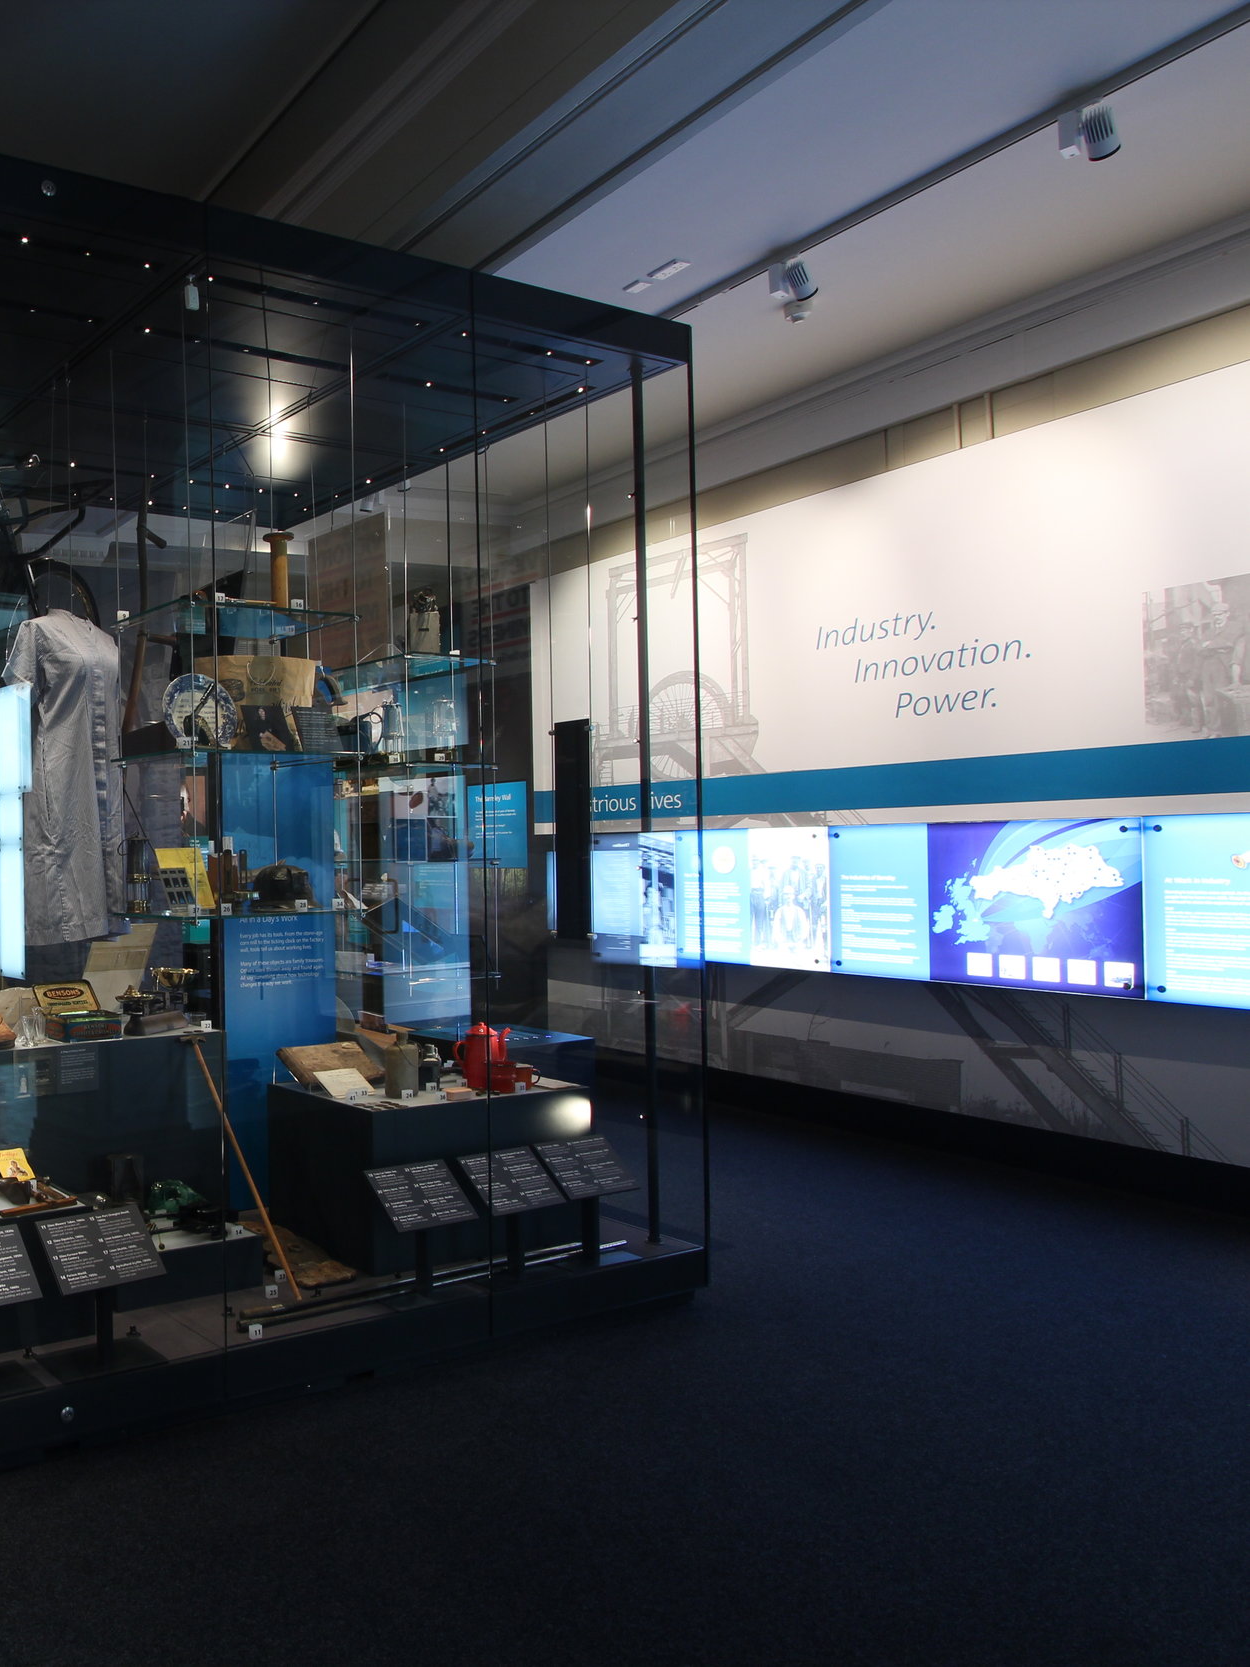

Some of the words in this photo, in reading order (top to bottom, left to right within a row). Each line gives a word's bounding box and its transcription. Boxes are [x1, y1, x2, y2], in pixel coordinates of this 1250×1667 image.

[816, 611, 936, 650] Industry.
[855, 638, 1031, 683] Innovation.
[895, 687, 996, 718] Power.
[651, 791, 682, 809] ives
